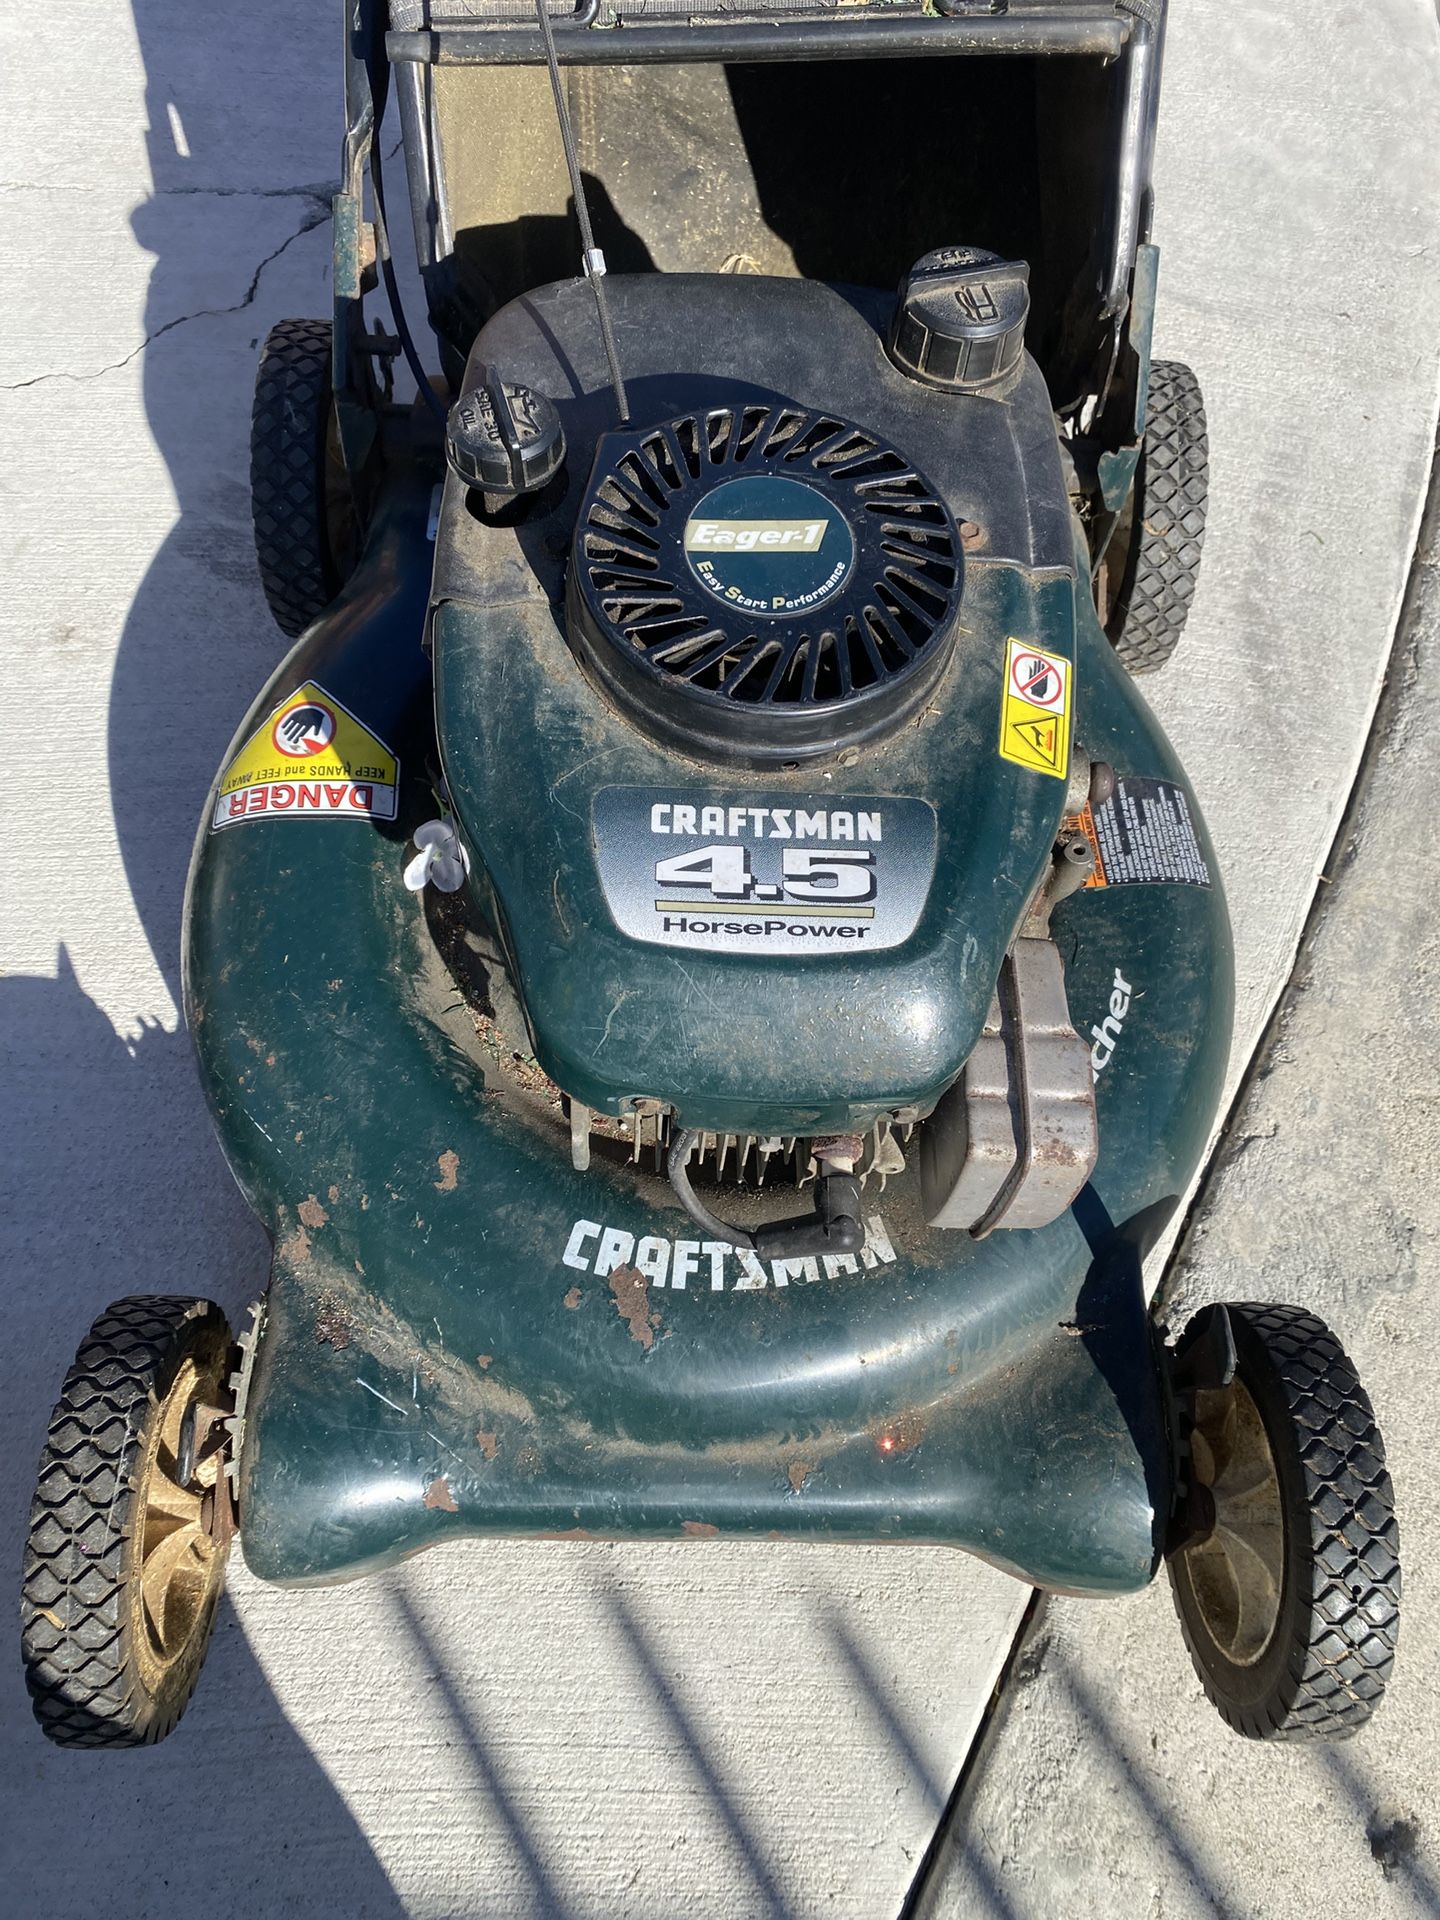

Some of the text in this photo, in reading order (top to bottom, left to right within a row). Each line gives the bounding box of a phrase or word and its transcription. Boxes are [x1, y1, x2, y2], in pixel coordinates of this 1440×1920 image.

[460, 409, 475, 430] OIL
[691, 524, 820, 550] Eager-1
[696, 560, 846, 610] Easy Start Performance
[227, 765, 385, 789] KEEP HANDS and FEET AWAY
[229, 784, 373, 816] DANGER
[650, 803, 882, 842] CRAFTSMAN
[655, 844, 878, 902] 4.5
[663, 917, 870, 938] HorsePower
[1091, 967, 1132, 1083] cher
